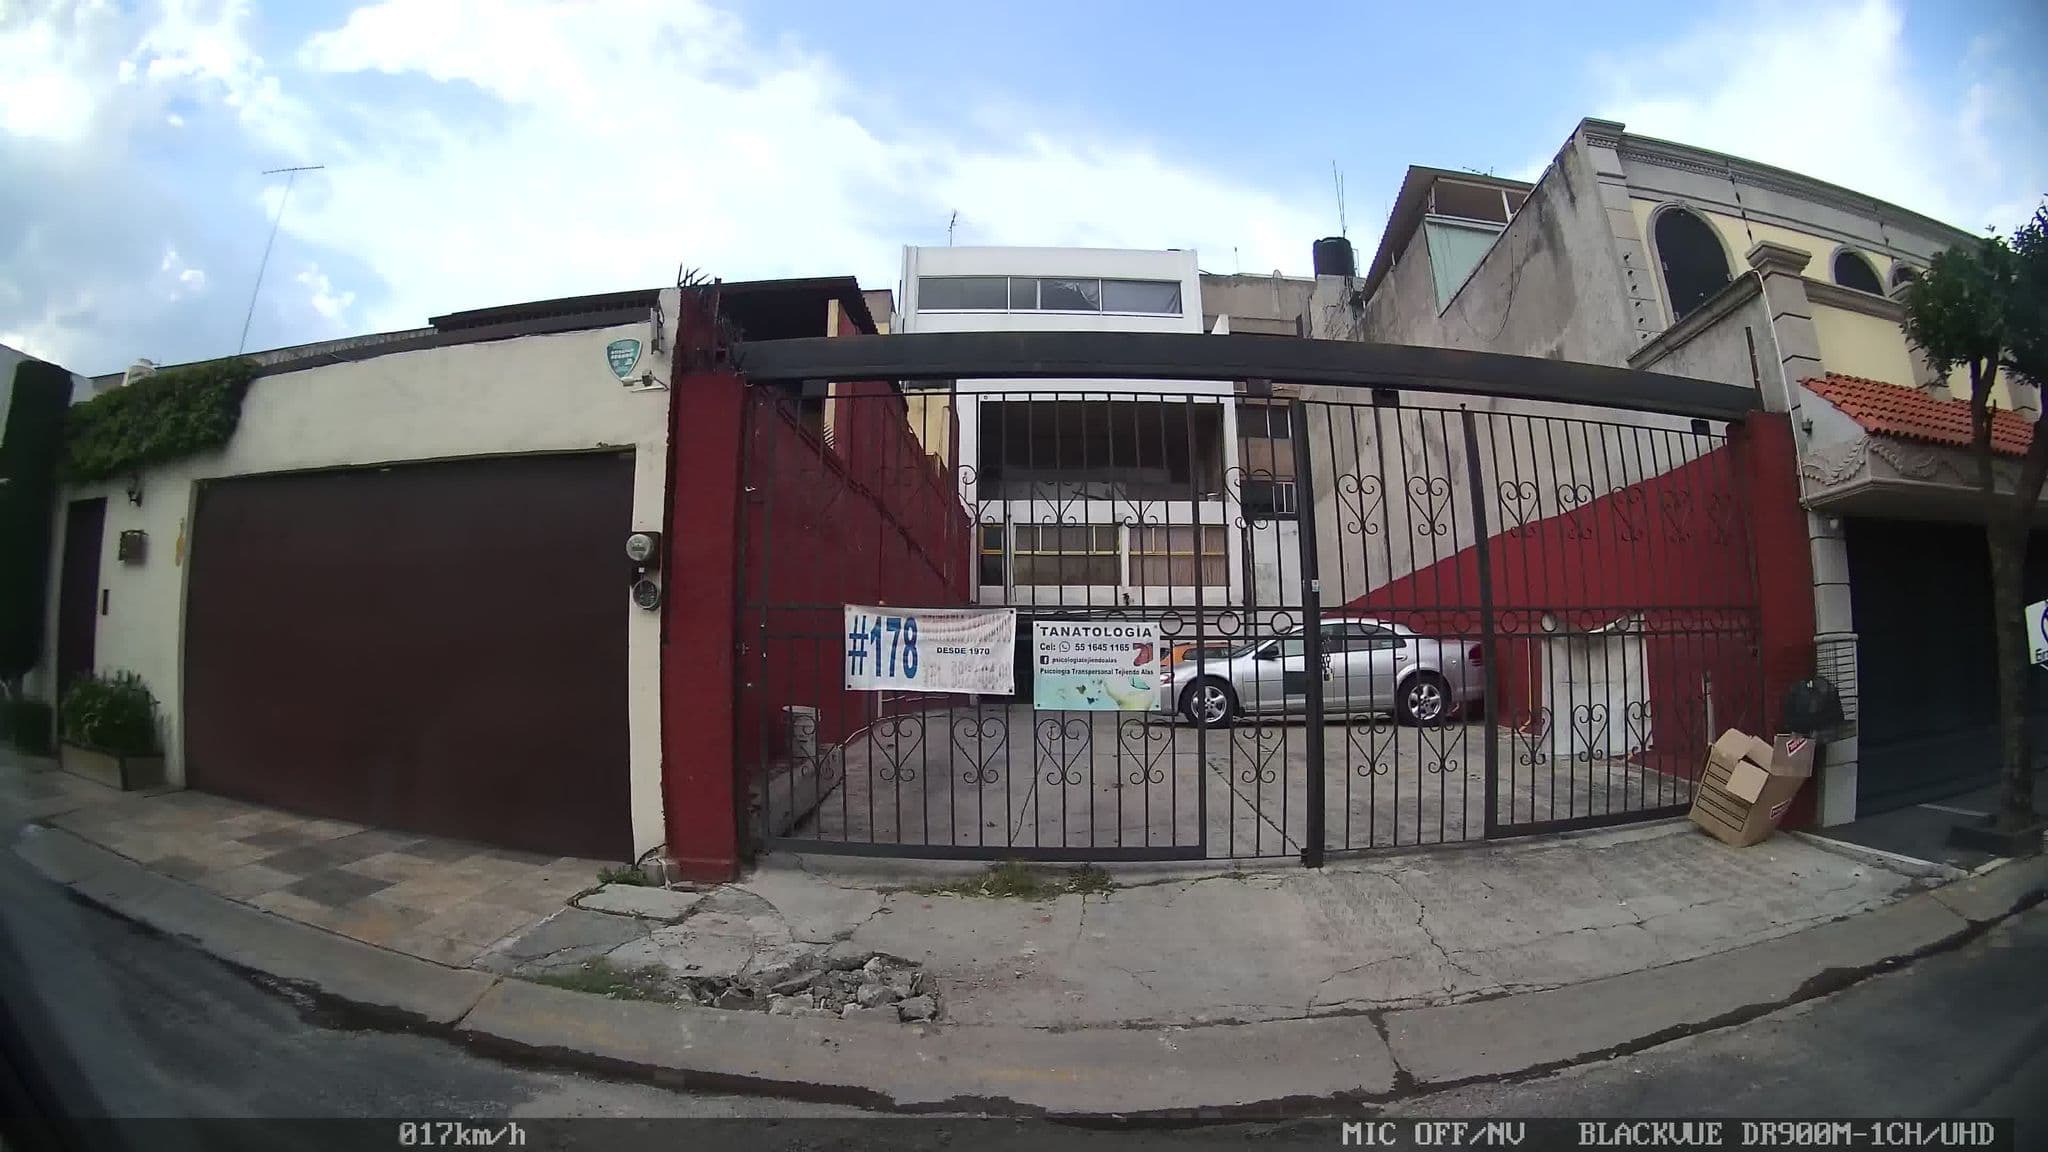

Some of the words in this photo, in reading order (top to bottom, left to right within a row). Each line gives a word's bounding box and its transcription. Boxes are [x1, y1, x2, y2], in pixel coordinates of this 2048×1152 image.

[848, 615, 918, 679] #178
[969, 647, 990, 655] 1970
[1040, 643, 1056, 651] Cel:
[1075, 643, 1085, 651] 55
[1088, 643, 1107, 651] 1645
[1110, 643, 1129, 651] 1165
[1072, 668, 1114, 676] Transpersonal
[1115, 668, 1140, 677] Tejiendo
